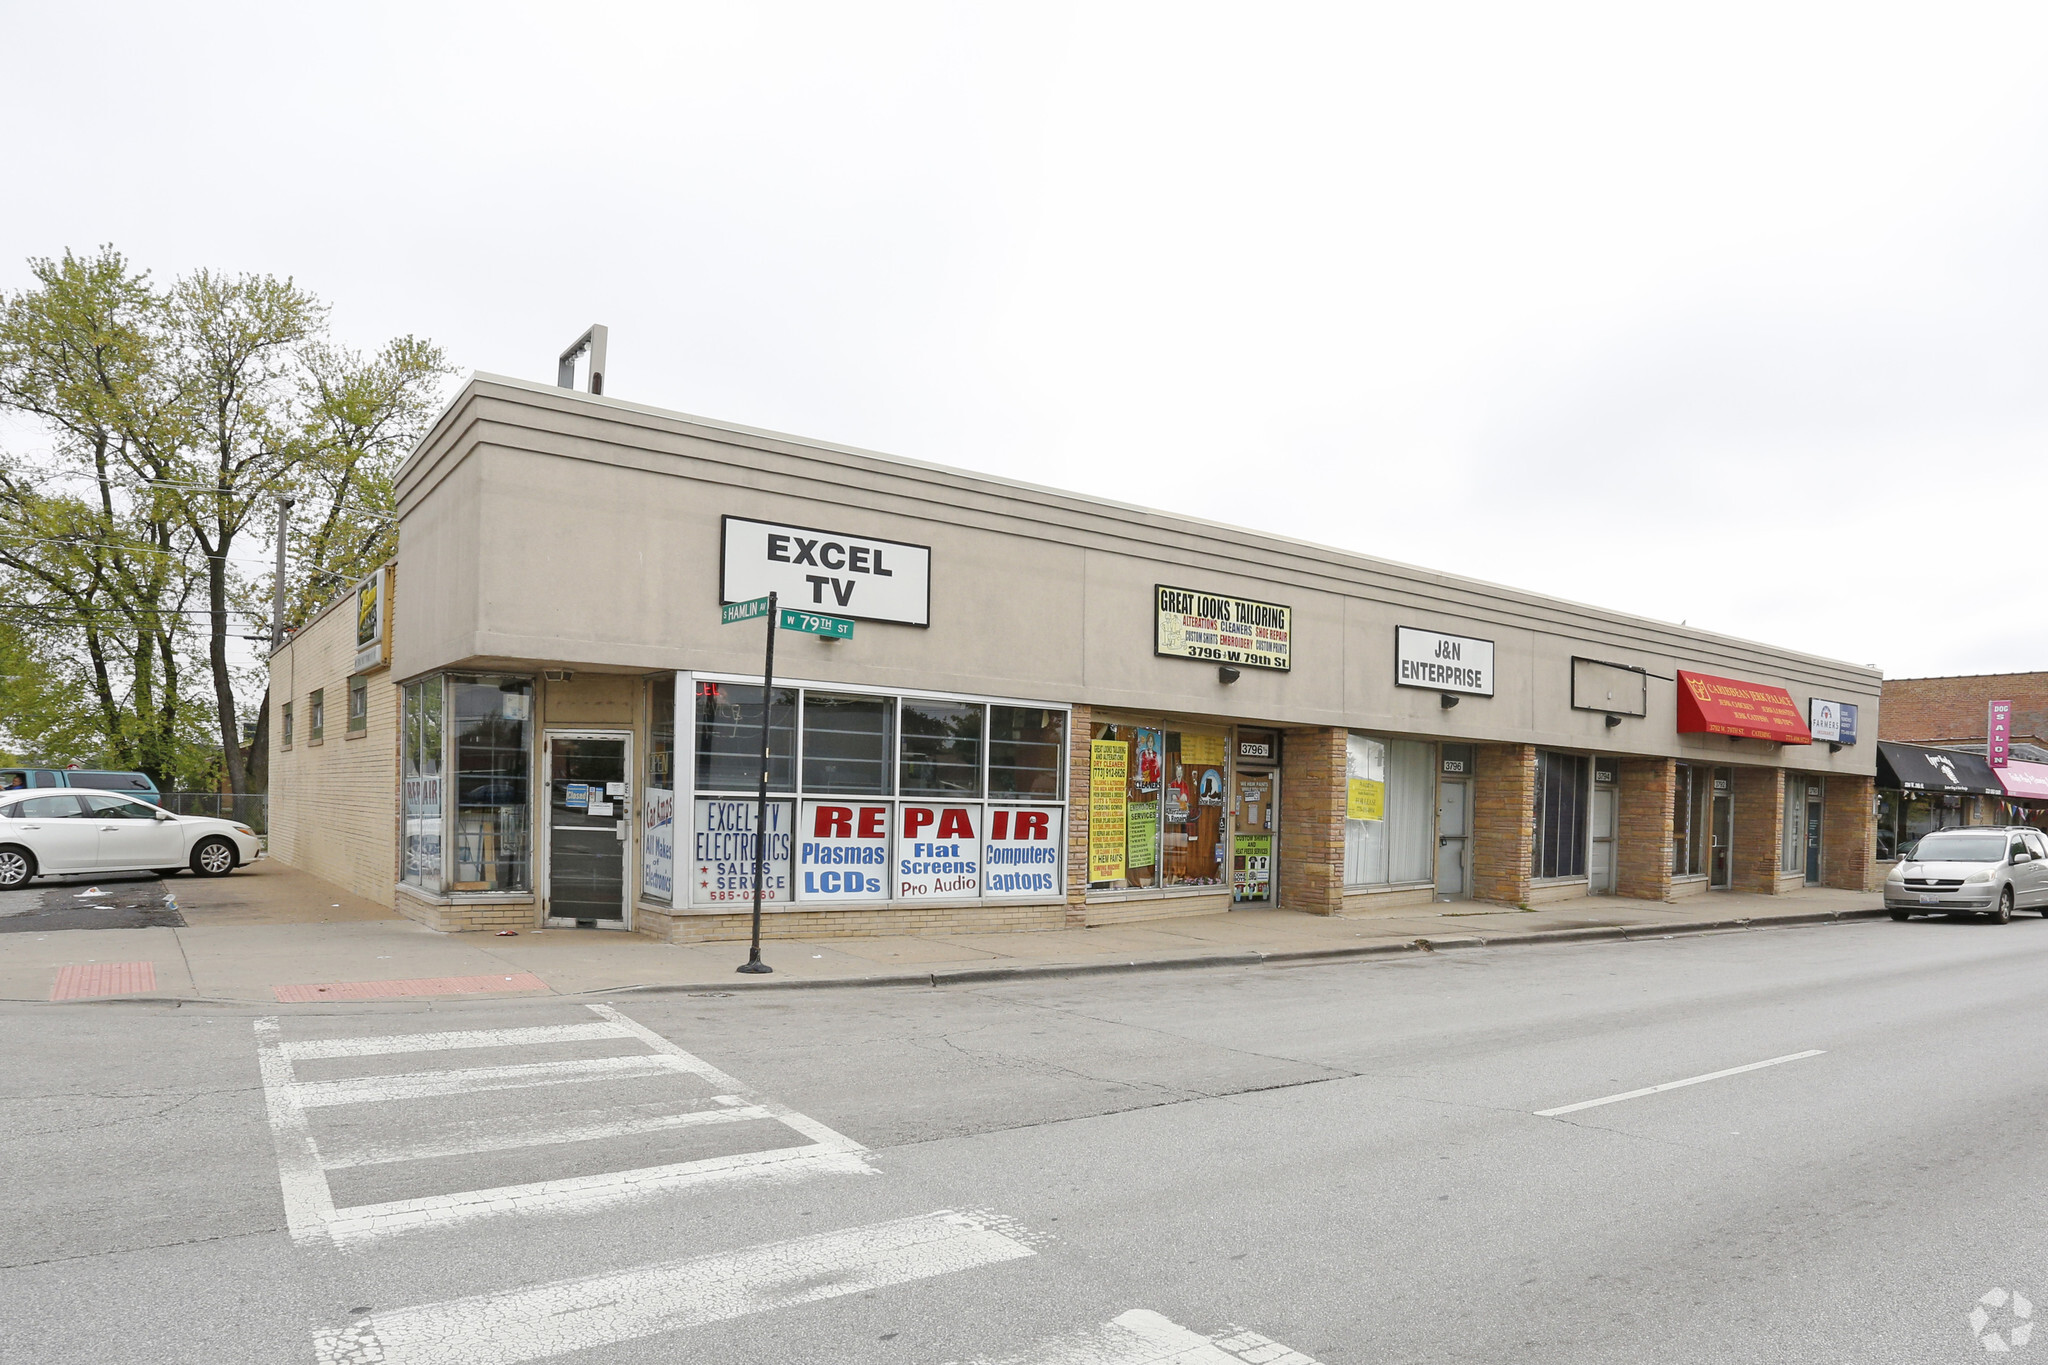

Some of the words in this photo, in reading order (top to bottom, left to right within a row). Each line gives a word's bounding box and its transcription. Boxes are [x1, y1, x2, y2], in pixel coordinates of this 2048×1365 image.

[767, 533, 892, 577] EXCEL
[806, 574, 856, 607] TV
[728, 602, 758, 620] HAMLIN
[759, 602, 766, 612] AV
[1160, 589, 1194, 615] GREAT
[1197, 596, 1230, 622] LOOKS
[1234, 602, 1285, 630] TAILORING
[787, 616, 795, 625] W
[800, 614, 832, 631] 79TH
[837, 624, 848, 634] ST
[1182, 615, 1218, 630] ALTERATIONS
[1220, 620, 1252, 636] CLEANERS
[1256, 626, 1268, 639] SHOE
[1270, 629, 1288, 642] REPAIR
[1186, 630, 1202, 643] CUSTOM
[1220, 634, 1254, 650] EMBROIDERY
[1256, 640, 1272, 652] CUSTOM
[1273, 642, 1288, 654] PRINTS
[1434, 640, 1461, 661] J&N
[1188, 645, 1222, 660] 3796
[1228, 650, 1242, 662] W.
[1244, 652, 1271, 666] 79th
[1274, 656, 1289, 668] St.
[1402, 659, 1482, 688] ENTERPRISE
[696, 682, 720, 696] EL
[1707, 683, 1750, 699] CARIBBEAN
[1749, 690, 1767, 702] JERK
[1766, 693, 1793, 706] PALACE
[1813, 718, 1839, 730] FARMERS
[1094, 744, 1103, 753] GREAT
[1242, 744, 1263, 754] 3796
[1994, 714, 2005, 764] SALON
[1093, 768, 1105, 779] (773)
[1445, 761, 1462, 771] 3796
[568, 791, 586, 800] Closed
[646, 801, 656, 829] Car
[656, 796, 672, 828] Amps
[1130, 802, 1156, 811] EMBROIDERY
[1131, 812, 1156, 820] SERVICES
[646, 834, 655, 856] All
[656, 837, 672, 860] Makes
[802, 843, 885, 865] Plasmas
[914, 843, 960, 858] Flat
[986, 844, 1056, 867] Computers
[717, 862, 771, 876] SALES
[900, 860, 976, 874] Screens
[1098, 854, 1109, 863] HEM
[1110, 854, 1122, 863] PANTS
[645, 864, 672, 892] Electronics
[717, 876, 785, 890] SERVCE
[804, 871, 881, 894] LCDs
[902, 882, 928, 897] Pro
[934, 875, 976, 894] Audio
[986, 871, 1053, 892] Laptops
